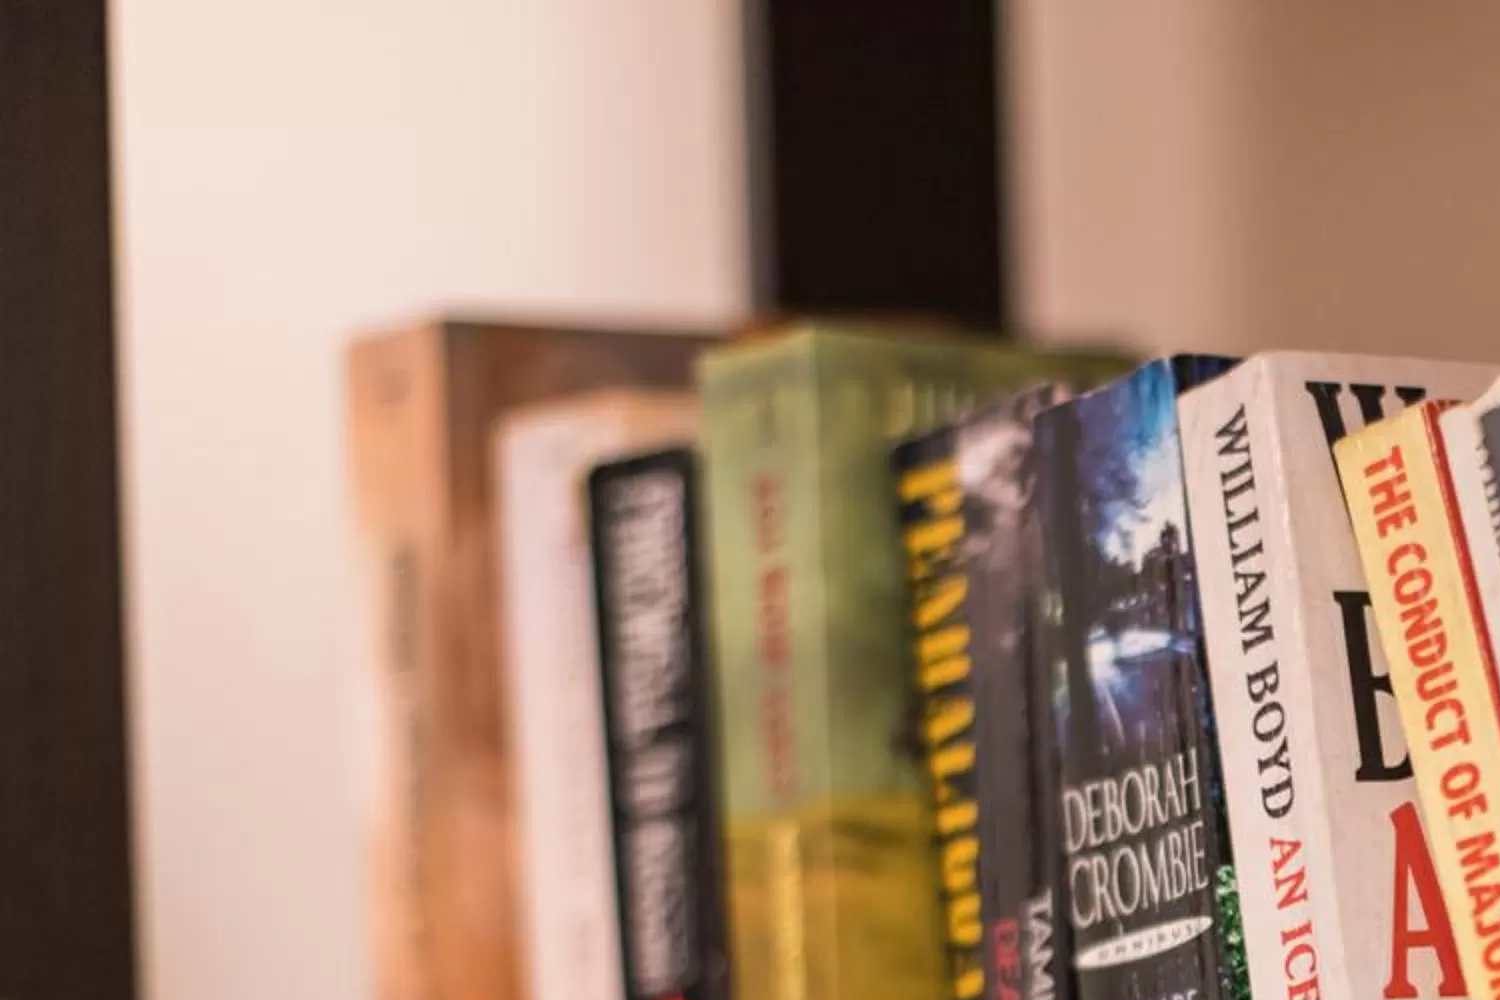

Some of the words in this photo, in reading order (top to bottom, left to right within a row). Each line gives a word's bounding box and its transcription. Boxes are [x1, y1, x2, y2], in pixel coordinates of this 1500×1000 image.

[1215, 402, 1275, 656] WILLIAM
[1363, 443, 1418, 540] THE
[1385, 541, 1472, 752] CONDUCT
[1246, 660, 1296, 820] BOYD
[1439, 762, 1489, 822] OF
[1062, 747, 1201, 853] DEBORAH
[1069, 820, 1209, 930] CROMBIE
[1269, 836, 1309, 911] AN
